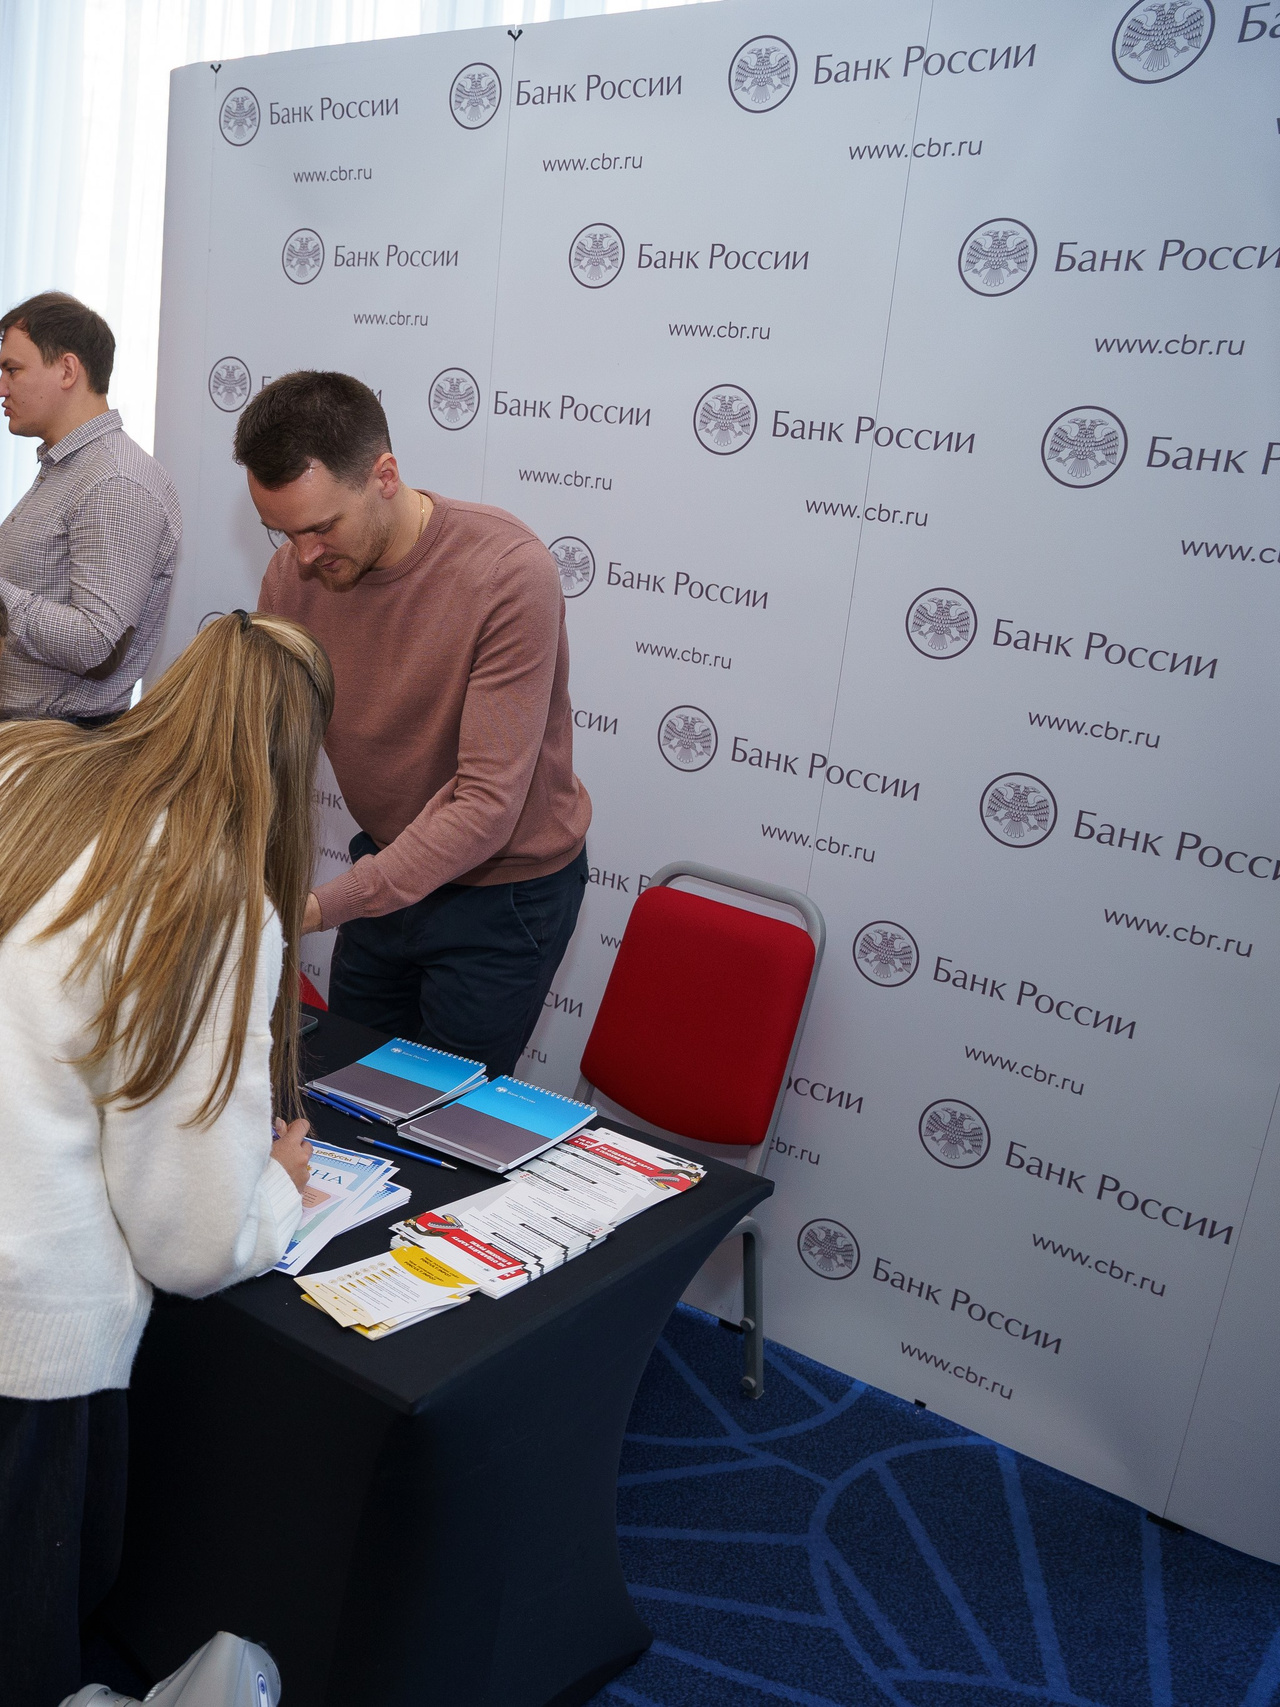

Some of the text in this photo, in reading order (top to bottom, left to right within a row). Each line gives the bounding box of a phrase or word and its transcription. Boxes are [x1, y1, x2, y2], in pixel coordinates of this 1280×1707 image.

[814, 44, 1036, 84] Банк России
[516, 75, 682, 105] Банк России
[270, 97, 398, 125] Банк России
[543, 153, 642, 172] www.cbr.ru
[849, 138, 982, 160] www.cbr.ru
[293, 166, 372, 183] www.cbr.ru
[334, 245, 458, 267] Банк России
[638, 244, 809, 270] Банк России
[1055, 240, 1280, 272] Банк Росси
[354, 311, 428, 326] www.cbr.ru
[669, 321, 770, 340] www.cbr.ru
[1095, 334, 1245, 355] www.cbr.ru
[494, 391, 650, 426] Банк России
[772, 410, 975, 453] Банк России
[1147, 436, 1248, 473] Банк
[519, 469, 612, 490] www.cbr.ru
[806, 500, 928, 526] www.cbr.ru
[607, 562, 768, 609] Банк России
[636, 641, 731, 669] www.cbr.ru
[993, 619, 1218, 679] Банк России
[571, 708, 618, 735] сии
[1029, 712, 1160, 748] www.cbr.ru
[731, 737, 920, 801] Банк России
[762, 824, 875, 863] www.cbr.ru
[1074, 810, 1280, 880] Банк Росс
[588, 866, 630, 893] анк
[1104, 909, 1252, 957] www.cbr.ru
[933, 956, 1136, 1039] Банк России
[965, 1046, 1084, 1095] www.cbr.ru
[1006, 1141, 1233, 1244] Банк России
[1033, 1234, 1165, 1296] www.cbr.ru
[873, 1257, 1061, 1354] Банк России
[901, 1342, 1012, 1399] www.cbr.ru
